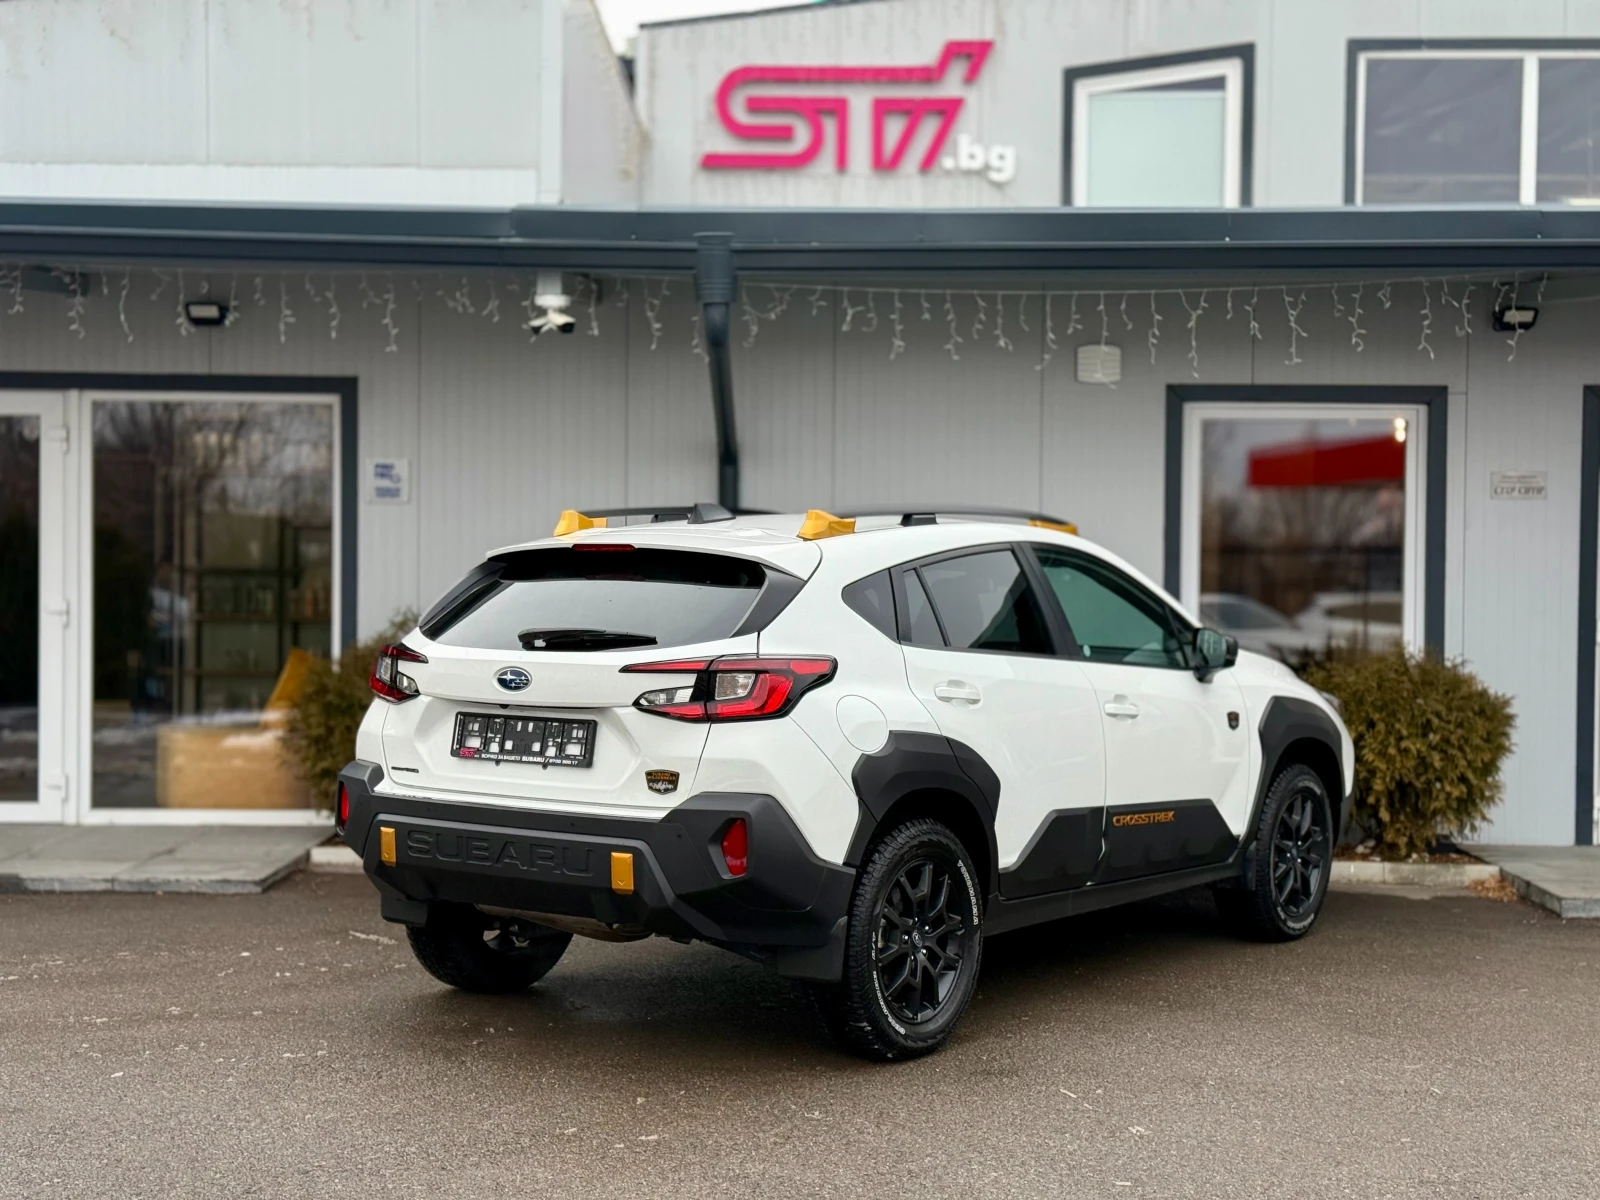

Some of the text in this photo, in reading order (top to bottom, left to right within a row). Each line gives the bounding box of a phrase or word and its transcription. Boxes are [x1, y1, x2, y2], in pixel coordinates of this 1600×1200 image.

[521, 755, 545, 763] SUBARU
[1112, 810, 1176, 827] CROSSTREK
[405, 828, 595, 877] SUBARU
